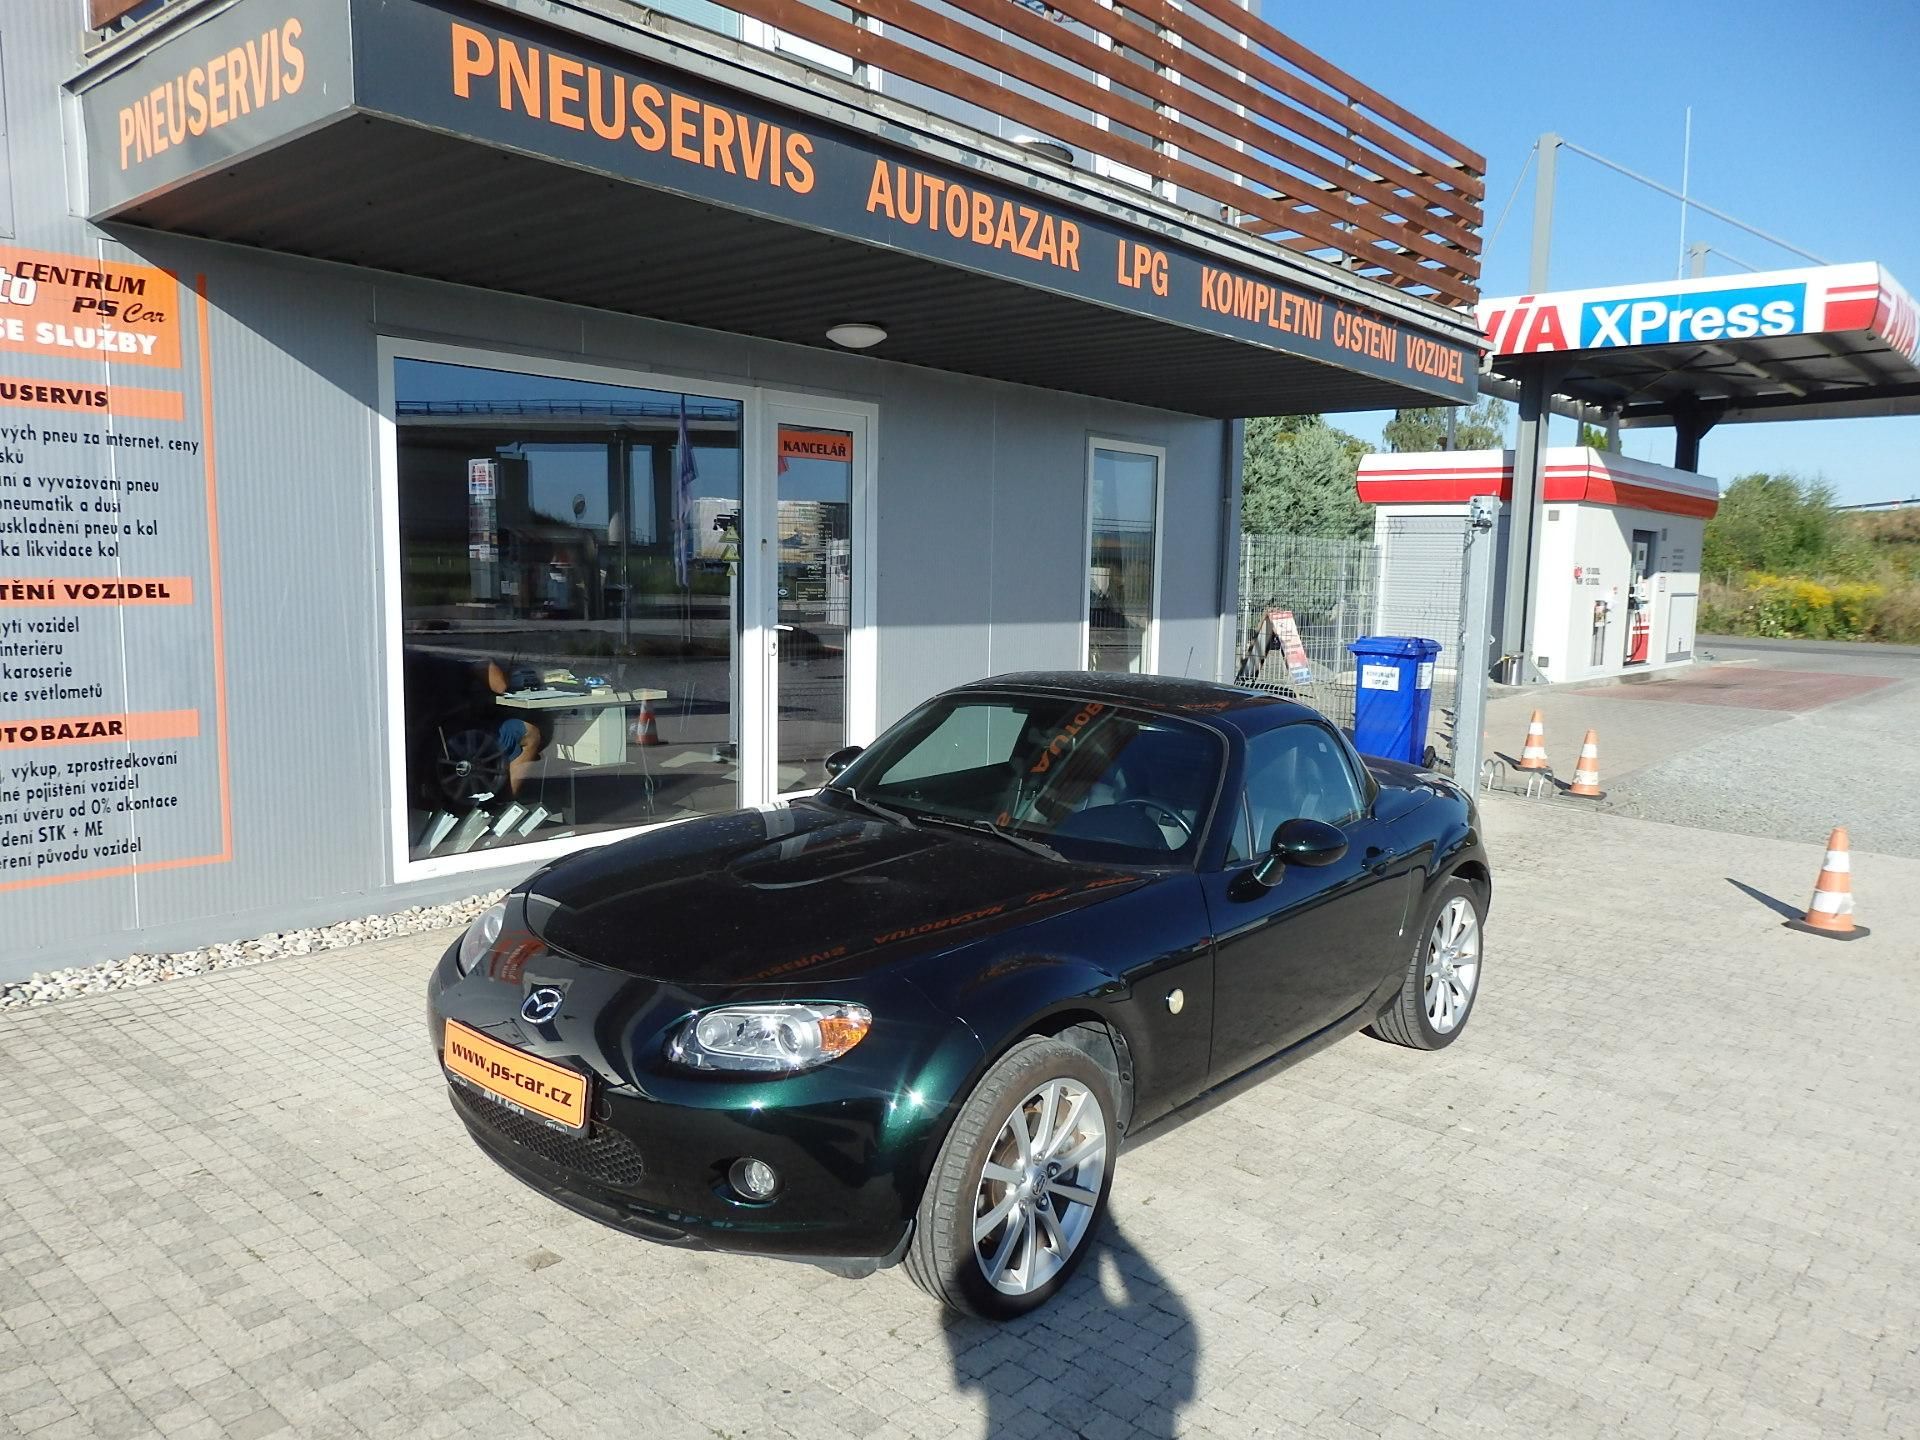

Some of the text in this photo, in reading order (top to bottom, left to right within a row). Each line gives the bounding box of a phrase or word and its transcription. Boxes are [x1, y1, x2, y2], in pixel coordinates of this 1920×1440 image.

[119, 17, 305, 171] PNEUSERVIS
[451, 22, 815, 194] PNEUSERVIS
[866, 159, 1080, 272] AUTOBAZAR
[1117, 239, 1168, 297] LPG
[1406, 334, 1465, 385] VOZIDEL
[16, 261, 146, 296] CENTRUM
[71, 295, 168, 324] PS Car
[1591, 298, 1798, 348] XPress
[35, 322, 158, 356] SLUŽBY
[0, 382, 109, 408] USERVIS
[1, 424, 37, 444] vých
[43, 430, 78, 446] pneu
[84, 433, 100, 446] za
[168, 438, 199, 456] ceny
[783, 440, 846, 457] KANCELÁŘ
[0, 472, 17, 488] ní
[23, 476, 31, 488] a
[126, 479, 159, 495] pneu
[80, 501, 88, 512] a
[85, 522, 118, 539] pneu
[124, 524, 132, 536] a
[137, 520, 157, 536] kol
[27, 540, 92, 557] likvidace
[98, 540, 119, 558] kol
[0, 580, 170, 600] TĚNÍ VOZIDEL
[0, 616, 80, 638] ytí vozidel
[3, 661, 72, 679] karoserie
[0, 682, 102, 702] ce světlometů
[0, 720, 123, 743] TOBAZAR
[67, 752, 178, 777] zprostředkování
[0, 774, 139, 804] né pojištění vozidel
[23, 807, 63, 823] úvěru
[70, 800, 85, 817] od
[91, 797, 111, 815] 0%
[117, 794, 178, 812] akontace
[38, 824, 66, 843] STK
[84, 820, 103, 838] ME
[0, 837, 142, 869] ření původu vozidel
[452, 1041, 573, 1107] www.ps-car.cz
